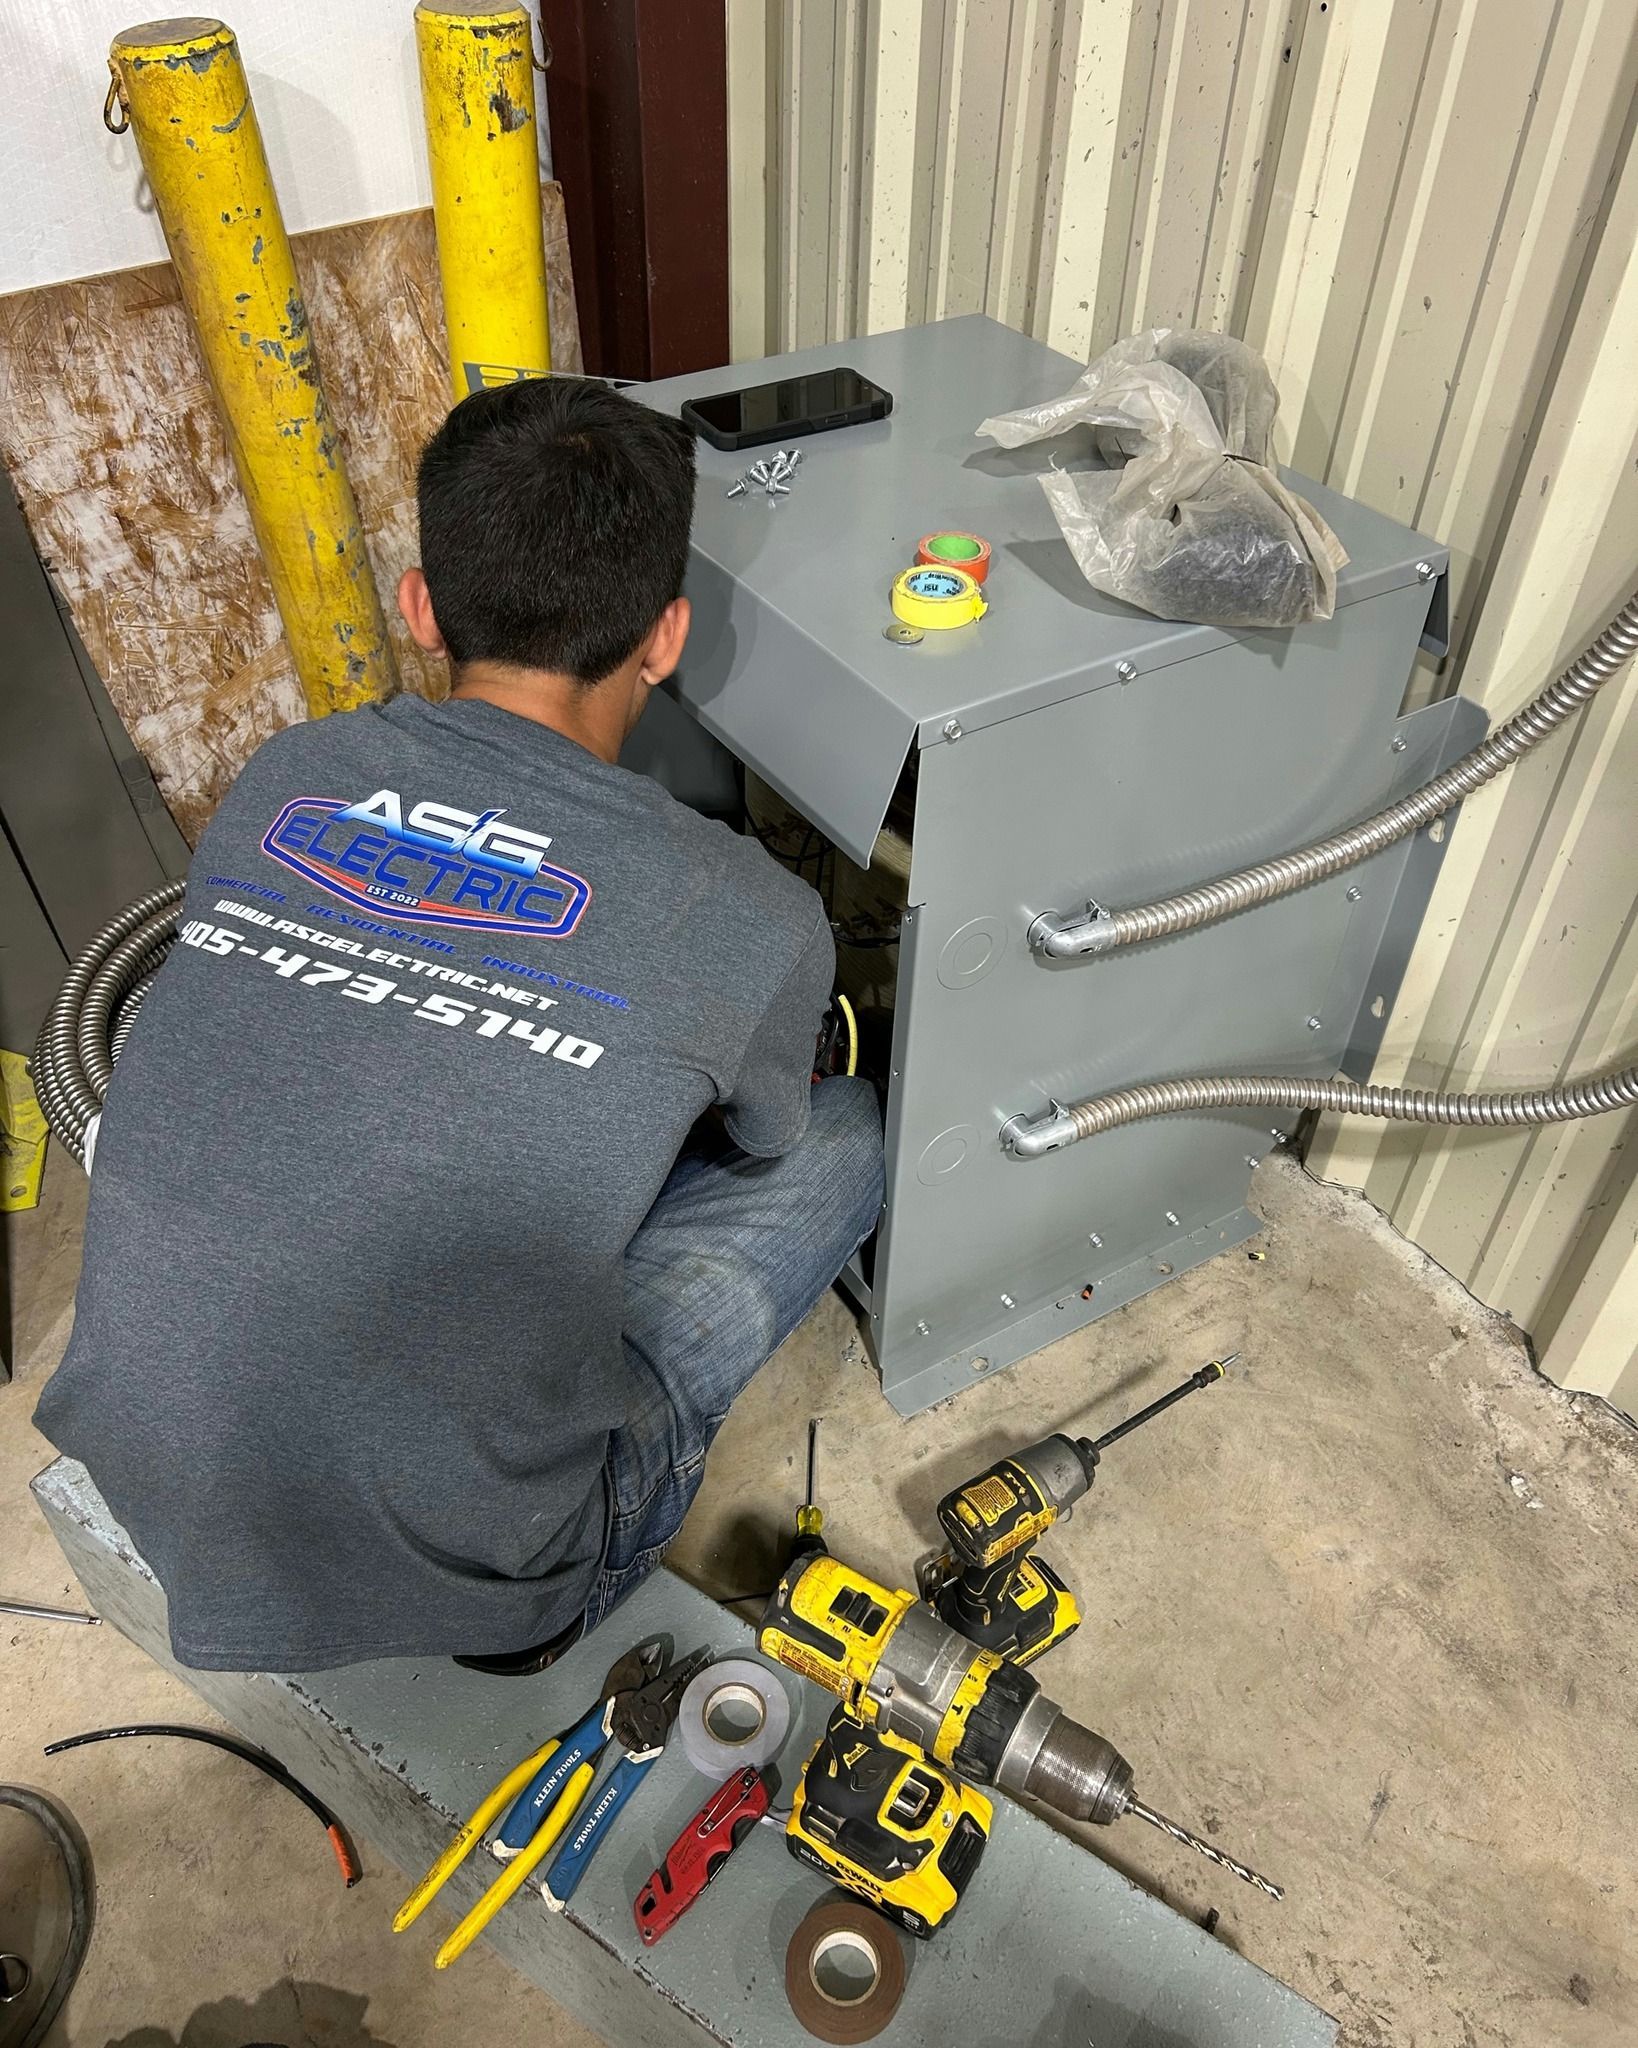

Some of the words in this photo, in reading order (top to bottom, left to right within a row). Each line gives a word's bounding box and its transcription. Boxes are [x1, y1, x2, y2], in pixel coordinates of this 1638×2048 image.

[276, 815, 566, 923] ELECTRIC
[328, 789, 555, 879] ASG
[366, 885, 387, 898] EST
[390, 889, 419, 906] 2022
[206, 875, 287, 904] COMMERCIAL
[304, 904, 457, 954] RESIDENTIAL
[480, 954, 631, 1011] INDUSTRIAL
[180, 920, 605, 1069] 405-473-5140
[534, 1776, 558, 1807] KLEIN
[555, 1749, 582, 1777] TOOLS
[594, 1787, 618, 1818] KLEIN
[573, 1818, 597, 1851] TOOLS
